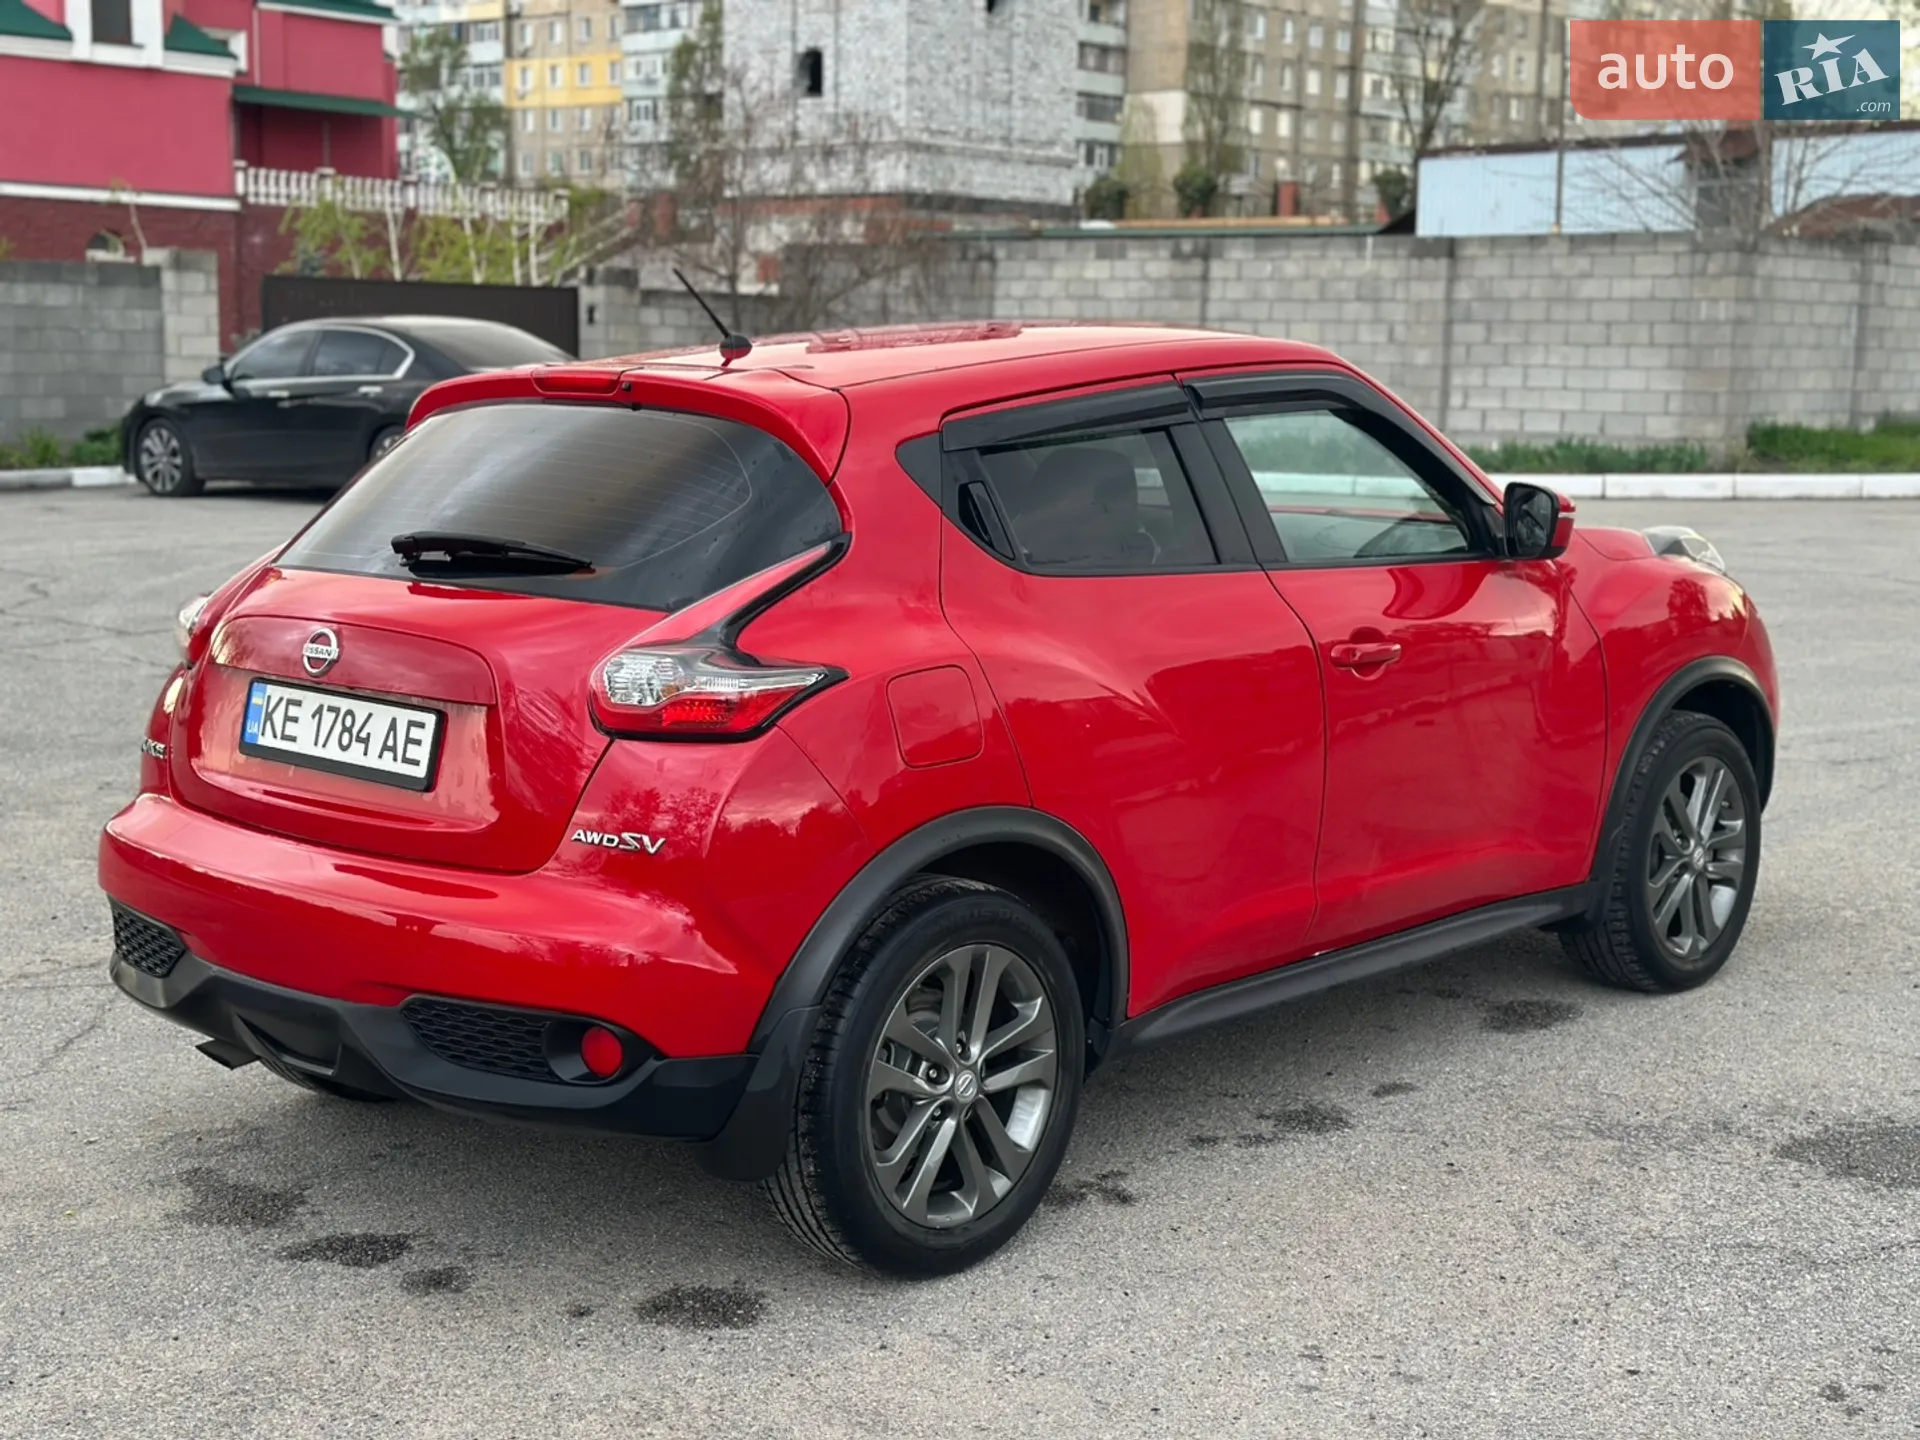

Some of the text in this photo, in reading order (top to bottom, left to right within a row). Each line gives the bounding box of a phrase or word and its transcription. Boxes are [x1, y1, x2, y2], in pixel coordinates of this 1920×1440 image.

[303, 646, 332, 657] SSAN
[247, 720, 259, 734] UA
[261, 695, 426, 766] KE 1784 AE
